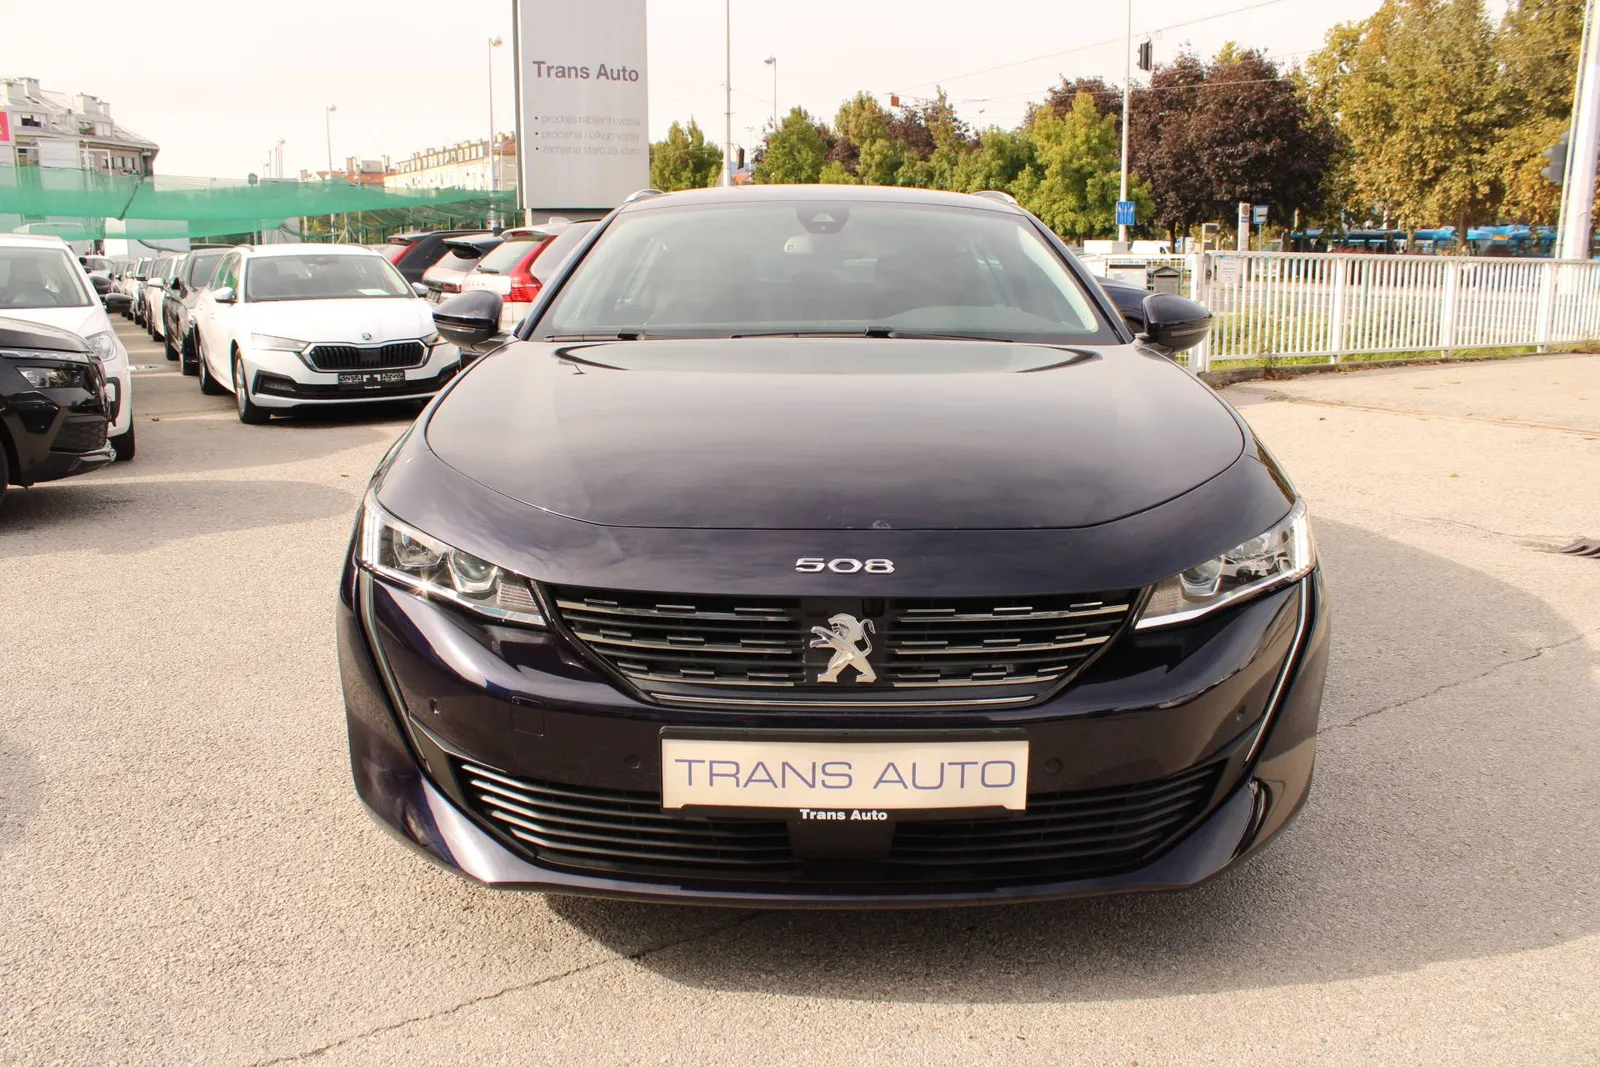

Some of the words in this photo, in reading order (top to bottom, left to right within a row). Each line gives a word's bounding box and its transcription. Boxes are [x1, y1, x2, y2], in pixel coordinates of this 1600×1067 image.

[532, 60, 590, 79] Trans
[596, 63, 639, 82] Auto
[795, 557, 895, 574] 508
[675, 758, 853, 790] TRANS
[873, 760, 1016, 790] AUTO
[800, 808, 846, 820] Trans
[850, 809, 888, 821] Auto
